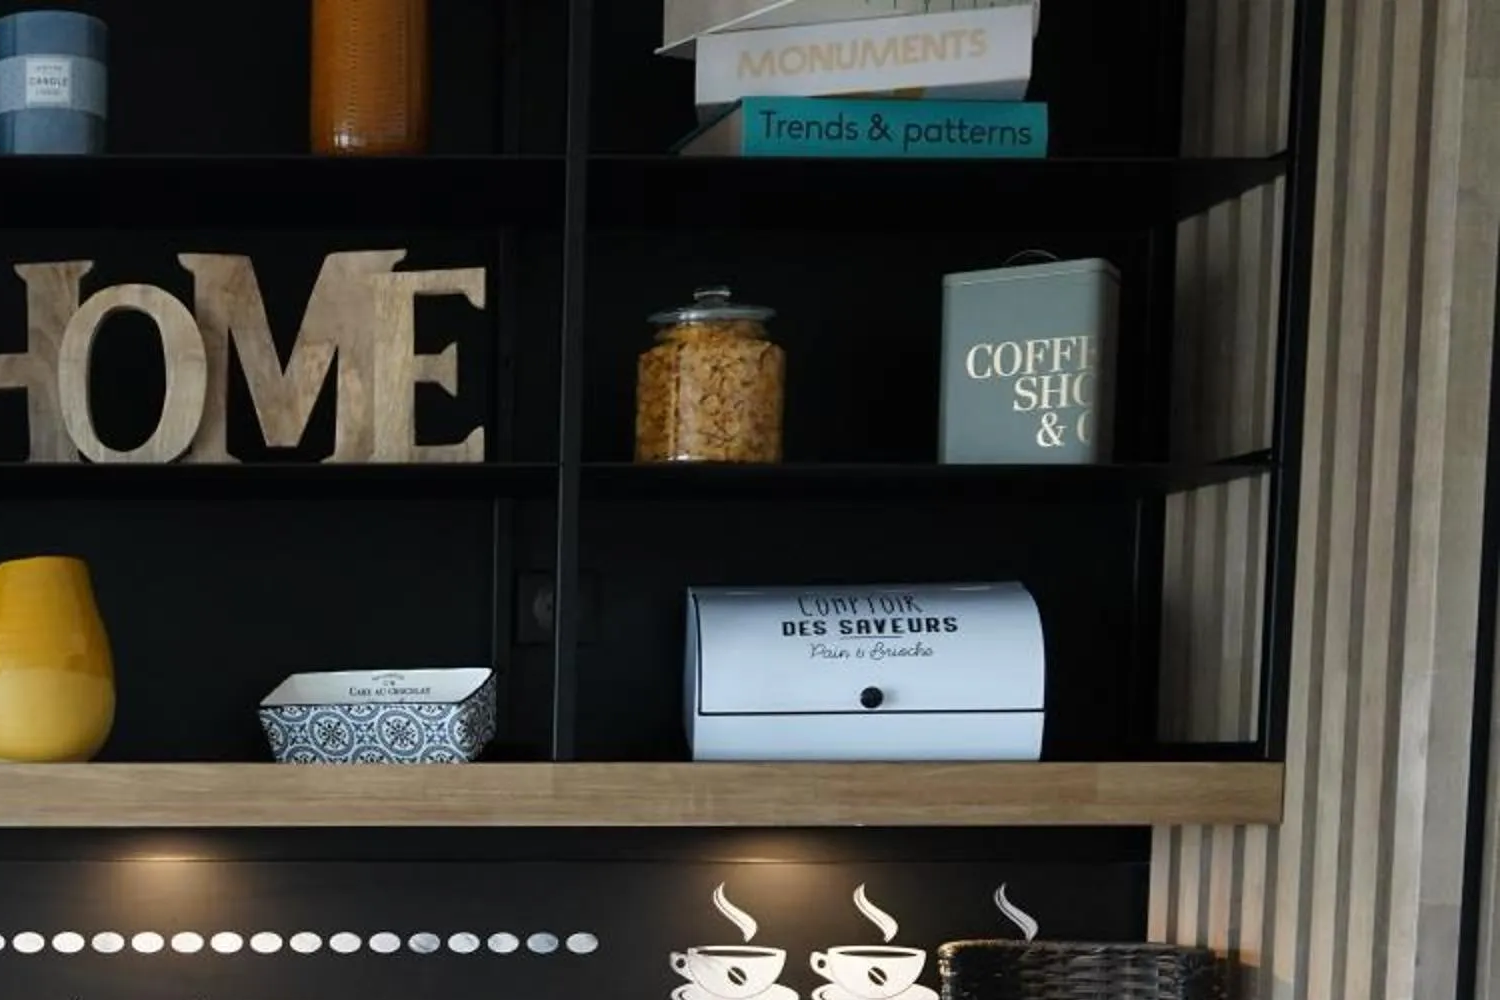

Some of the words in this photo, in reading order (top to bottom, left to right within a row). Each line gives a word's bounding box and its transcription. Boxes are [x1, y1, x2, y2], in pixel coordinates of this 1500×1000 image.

[736, 28, 989, 81] MONUMENTS
[758, 109, 859, 142] Trends
[867, 114, 894, 142] &
[902, 120, 1033, 152] patterns
[1035, 411, 1067, 447] &
[781, 620, 828, 637] DES
[838, 616, 959, 636] SAVEURS
[808, 642, 850, 660] Pain
